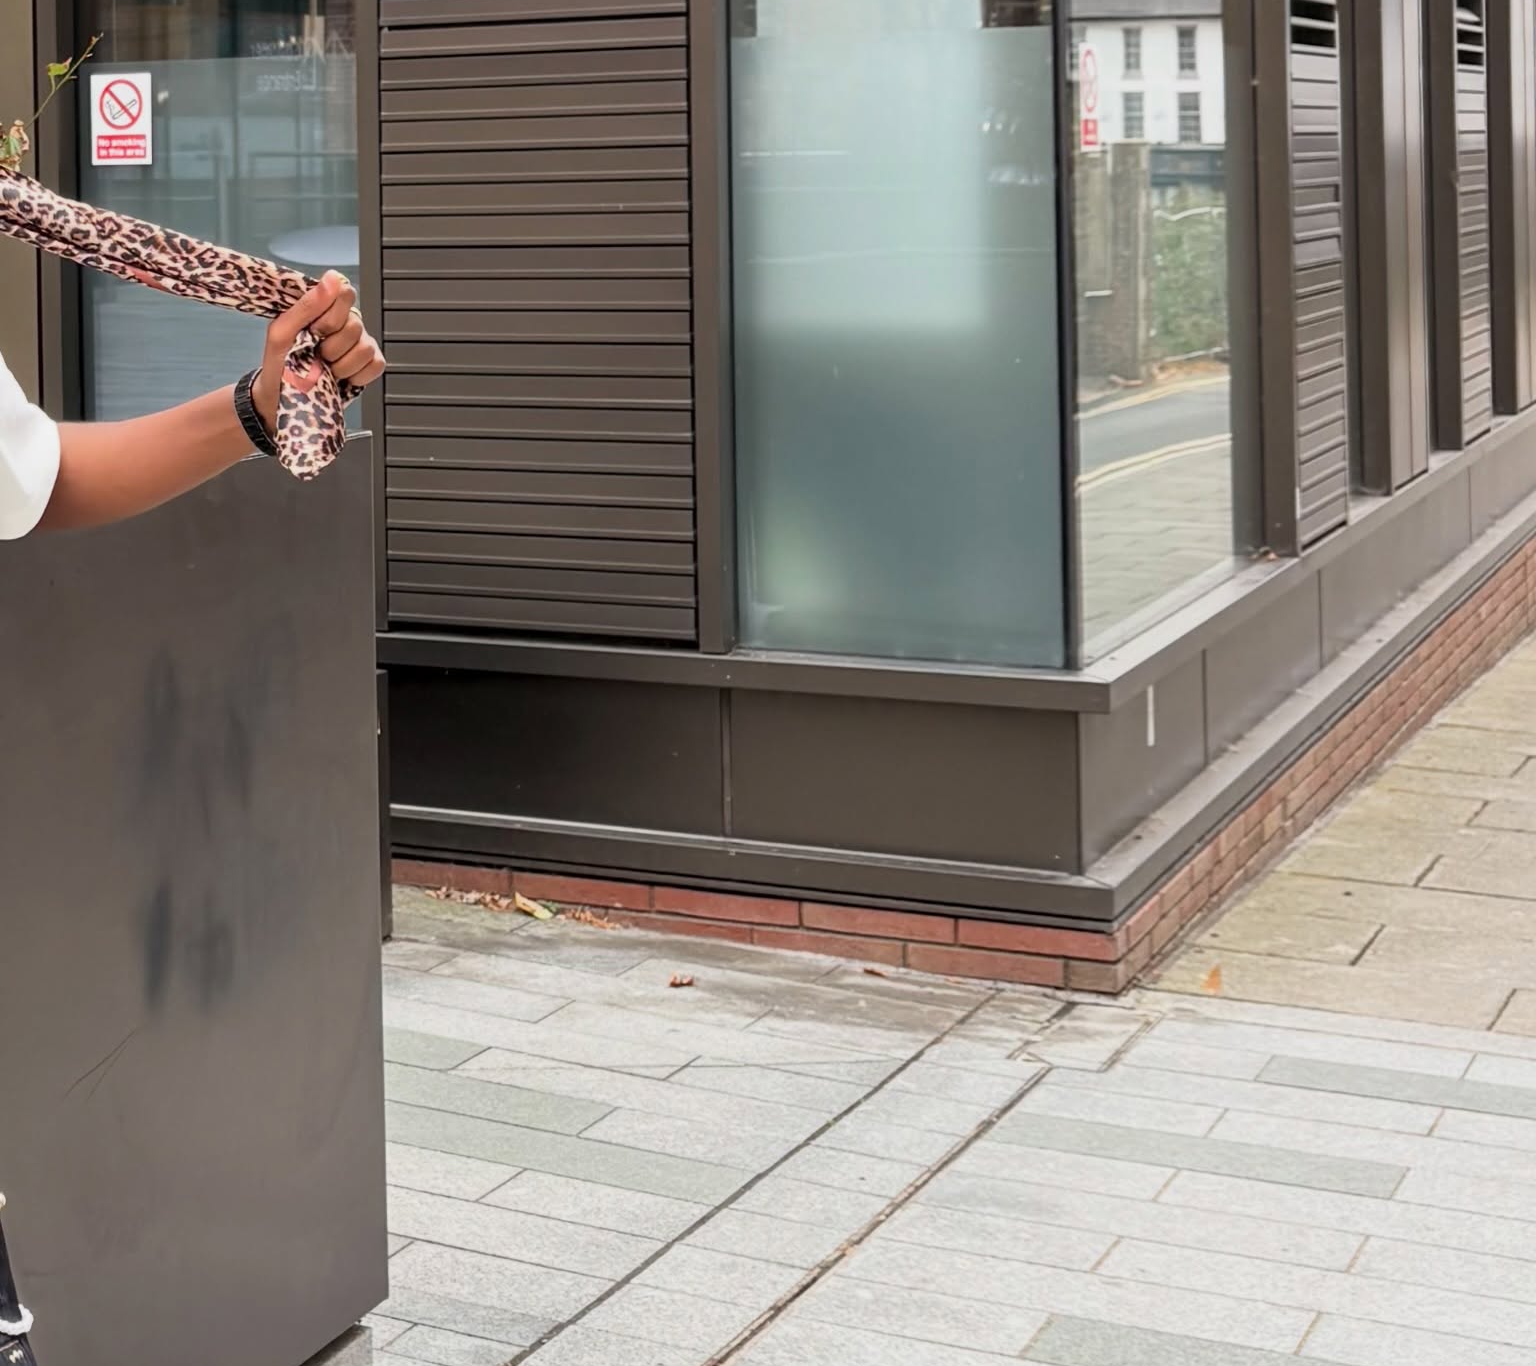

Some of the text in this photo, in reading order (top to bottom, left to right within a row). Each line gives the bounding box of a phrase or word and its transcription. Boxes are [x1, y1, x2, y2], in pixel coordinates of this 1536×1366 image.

[98, 138, 146, 148] No smoking
[99, 148, 145, 156] in this area
